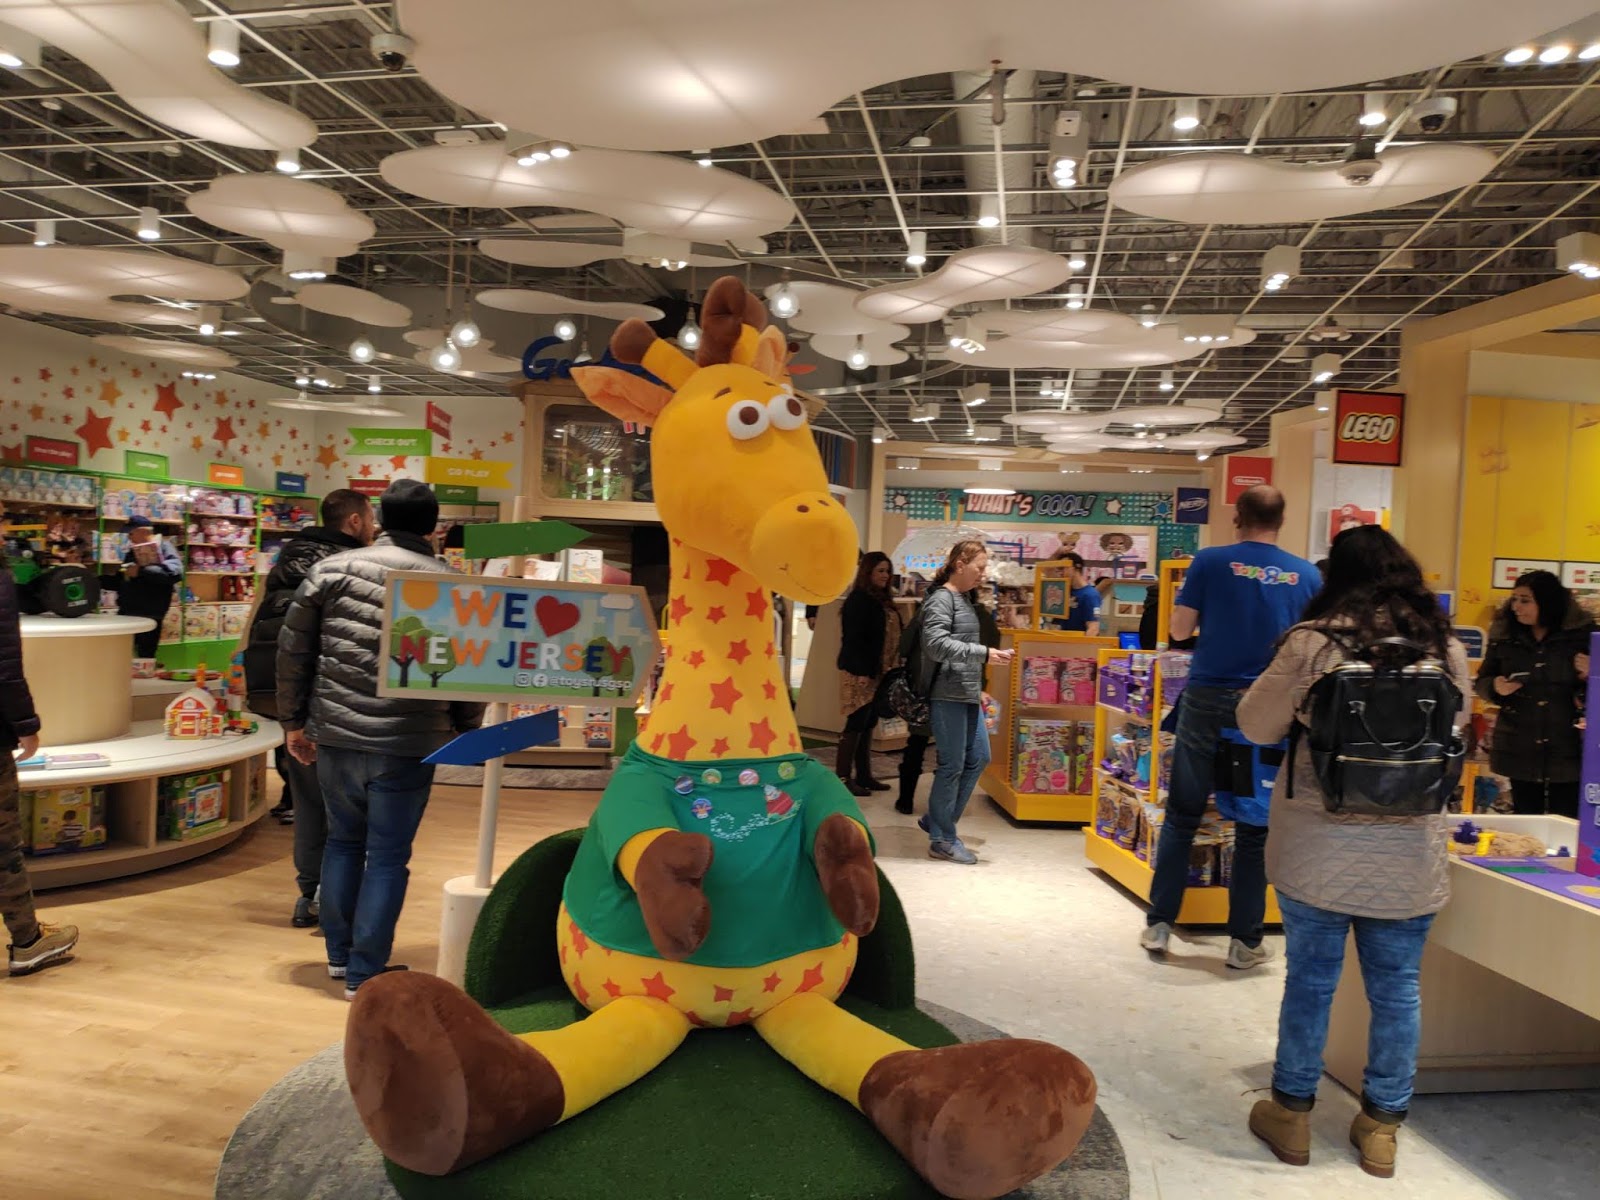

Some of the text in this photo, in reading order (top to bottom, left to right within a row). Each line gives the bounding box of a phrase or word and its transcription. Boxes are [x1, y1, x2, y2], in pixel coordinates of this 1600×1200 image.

[1342, 414, 1396, 442] LEGO
[966, 493, 1097, 517] WHAT'S COOL!
[452, 589, 529, 629] WE
[400, 635, 632, 674] NEW JERSEY
